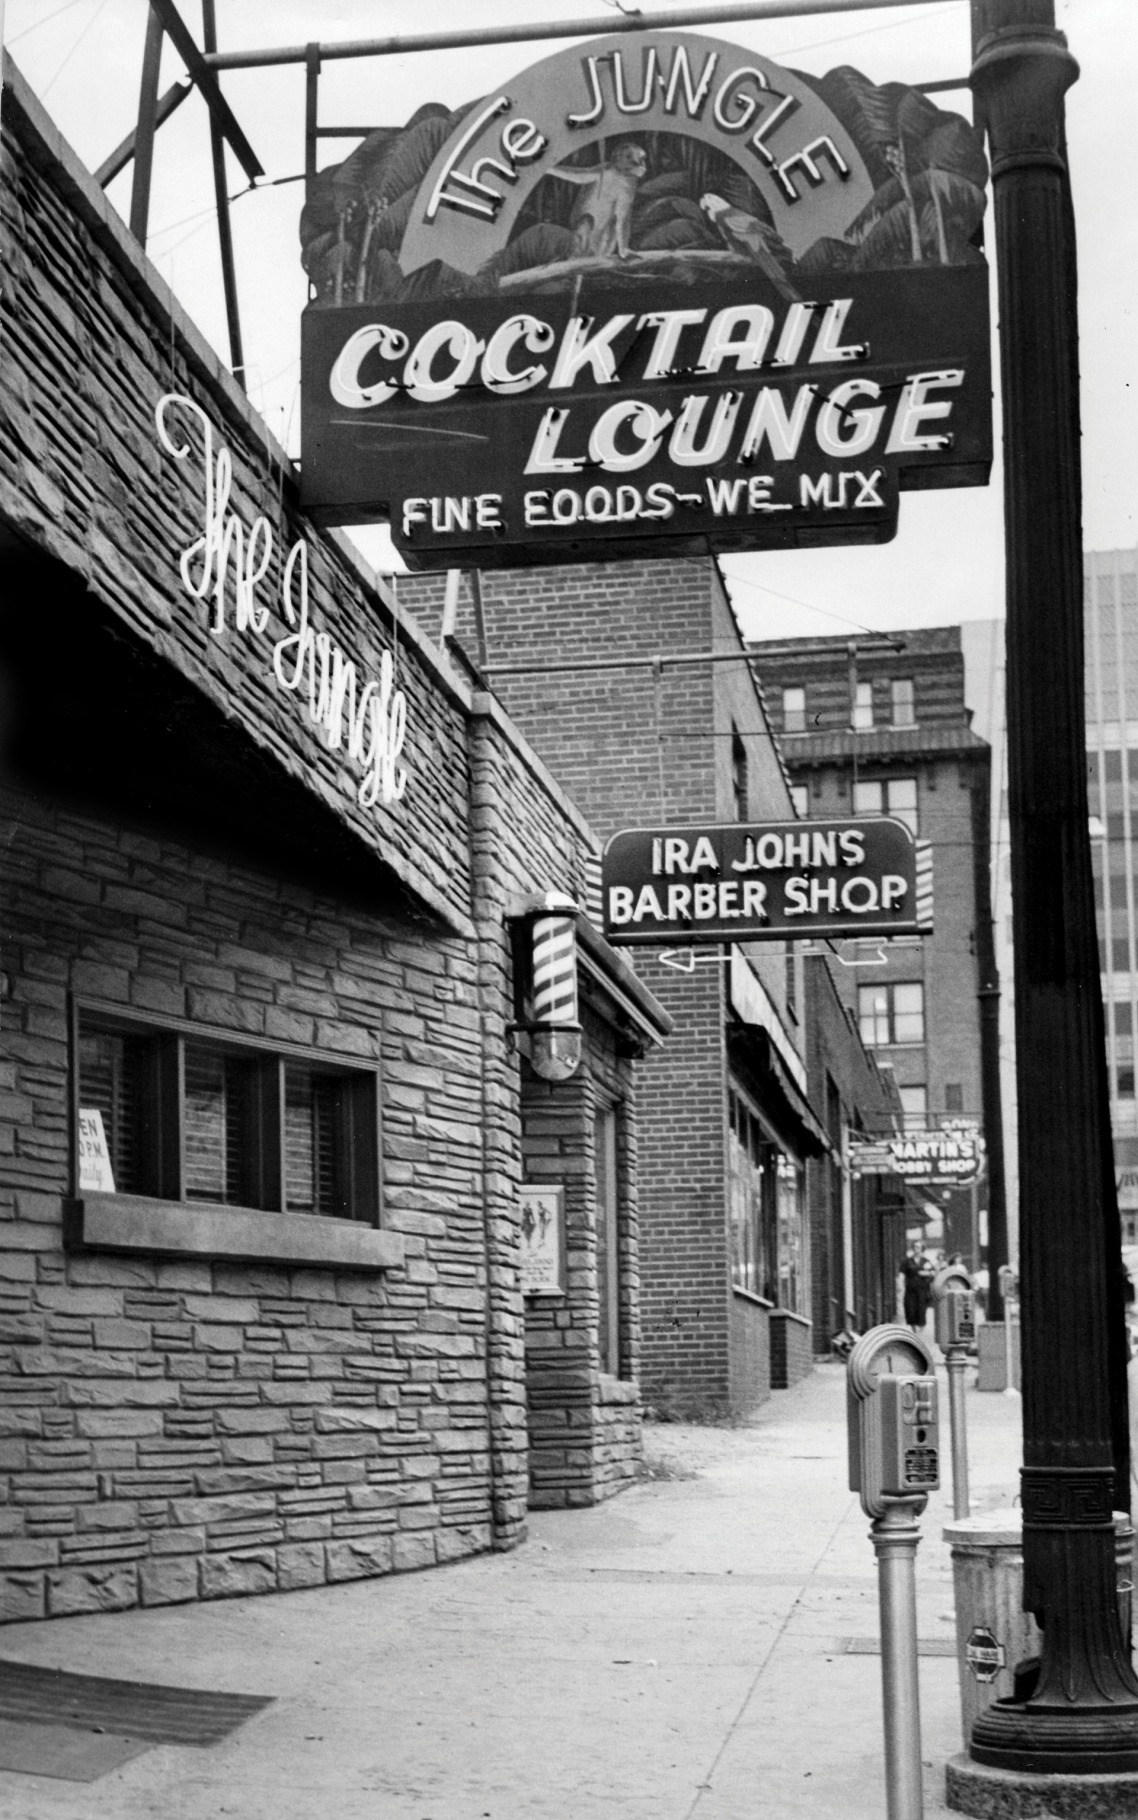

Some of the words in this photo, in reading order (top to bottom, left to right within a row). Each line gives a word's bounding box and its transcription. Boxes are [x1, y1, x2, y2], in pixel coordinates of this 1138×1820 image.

[427, 95, 547, 222] The
[567, 45, 850, 205] JUNGLE
[330, 299, 869, 408] COCKTAIL
[524, 370, 965, 475] LOUNGE
[403, 494, 501, 536] FINE
[799, 469, 885, 511] MIX
[155, 394, 272, 633] The
[273, 538, 407, 807] Jungle
[608, 881, 768, 925] BARBER
[784, 875, 908, 916] SHOP
[652, 836, 719, 875] IRA
